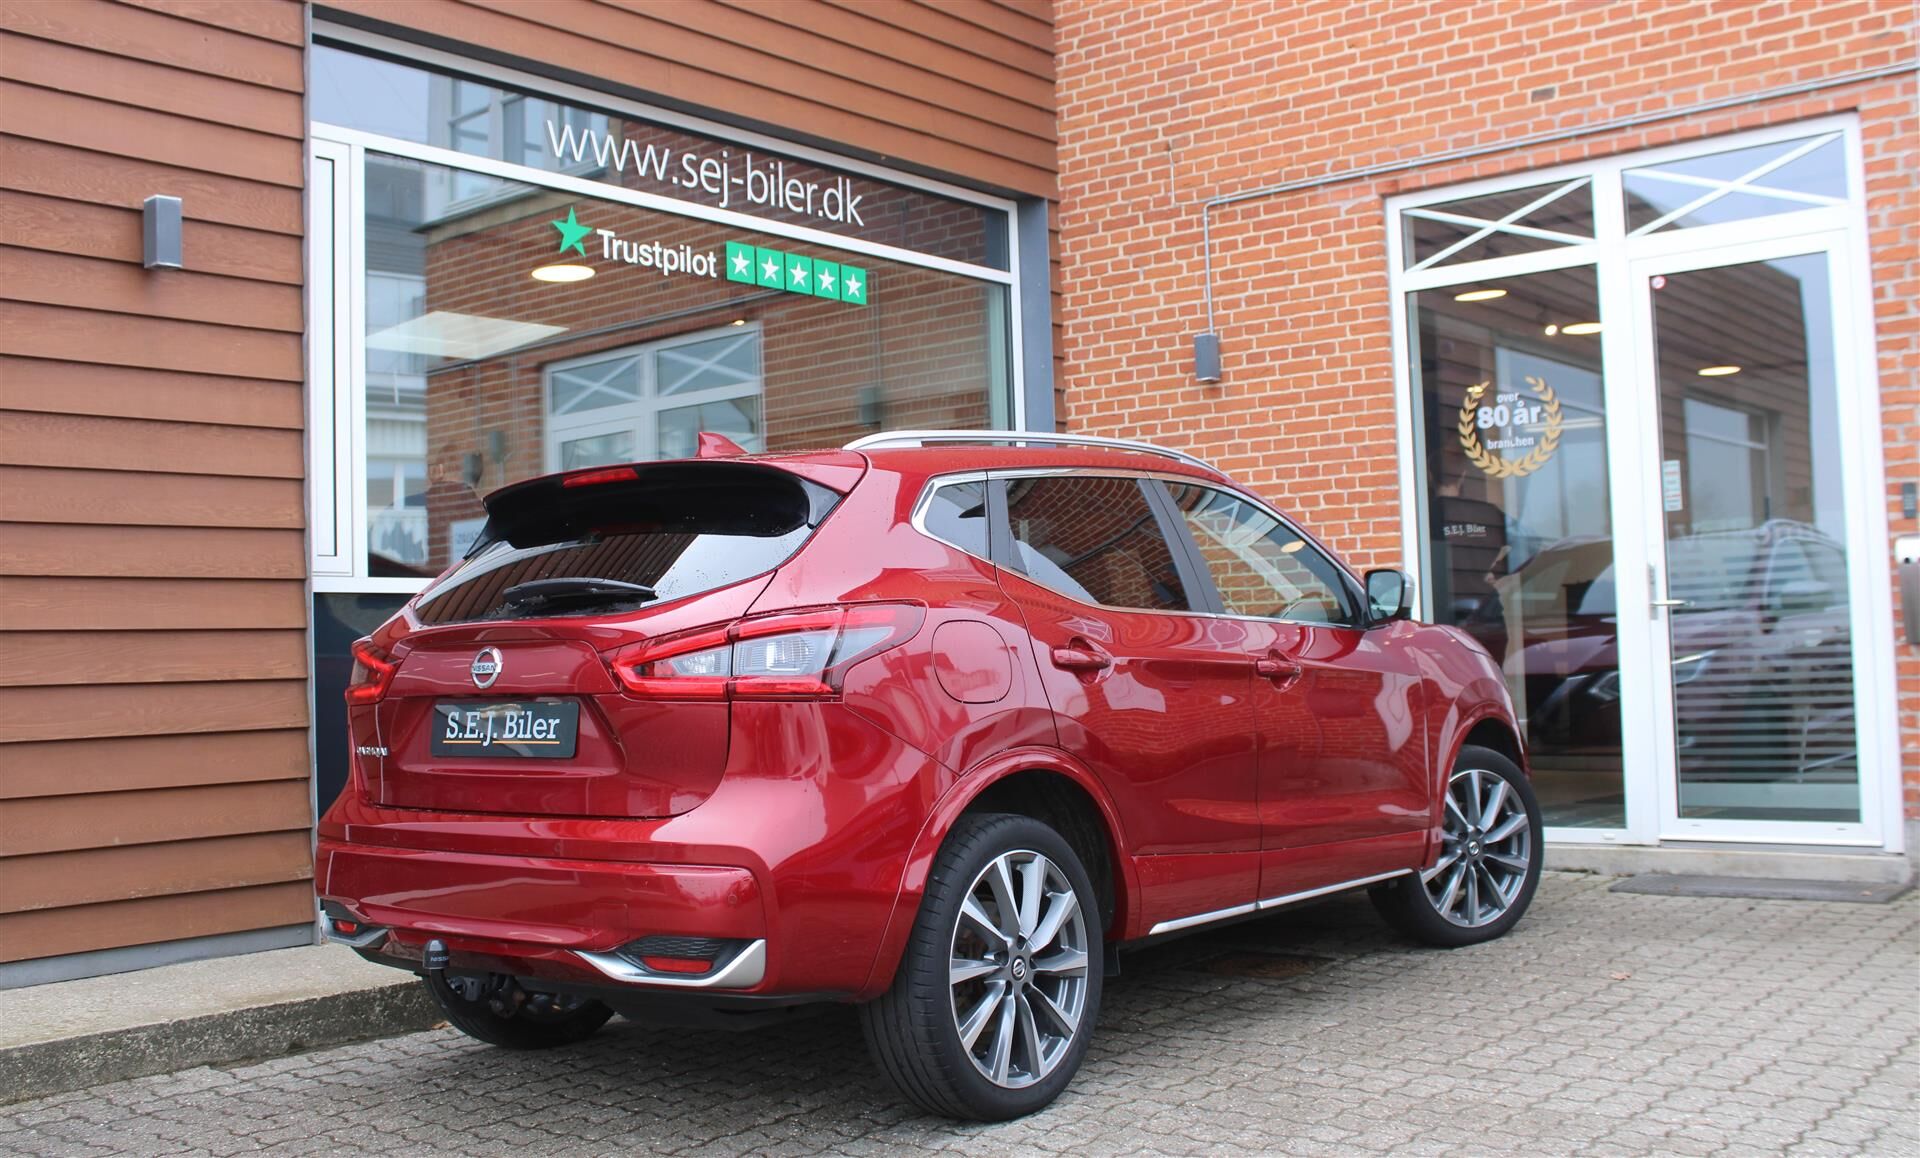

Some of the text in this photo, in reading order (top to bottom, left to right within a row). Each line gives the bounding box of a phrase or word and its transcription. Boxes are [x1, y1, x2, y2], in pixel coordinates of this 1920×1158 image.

[546, 119, 865, 227] www.sej-biler.dk
[596, 228, 718, 279] Trustpilot
[1496, 392, 1520, 404] over
[1477, 400, 1542, 429] 80 år
[473, 663, 497, 673] NISSAN
[446, 710, 560, 746] S.E.J. Biler
